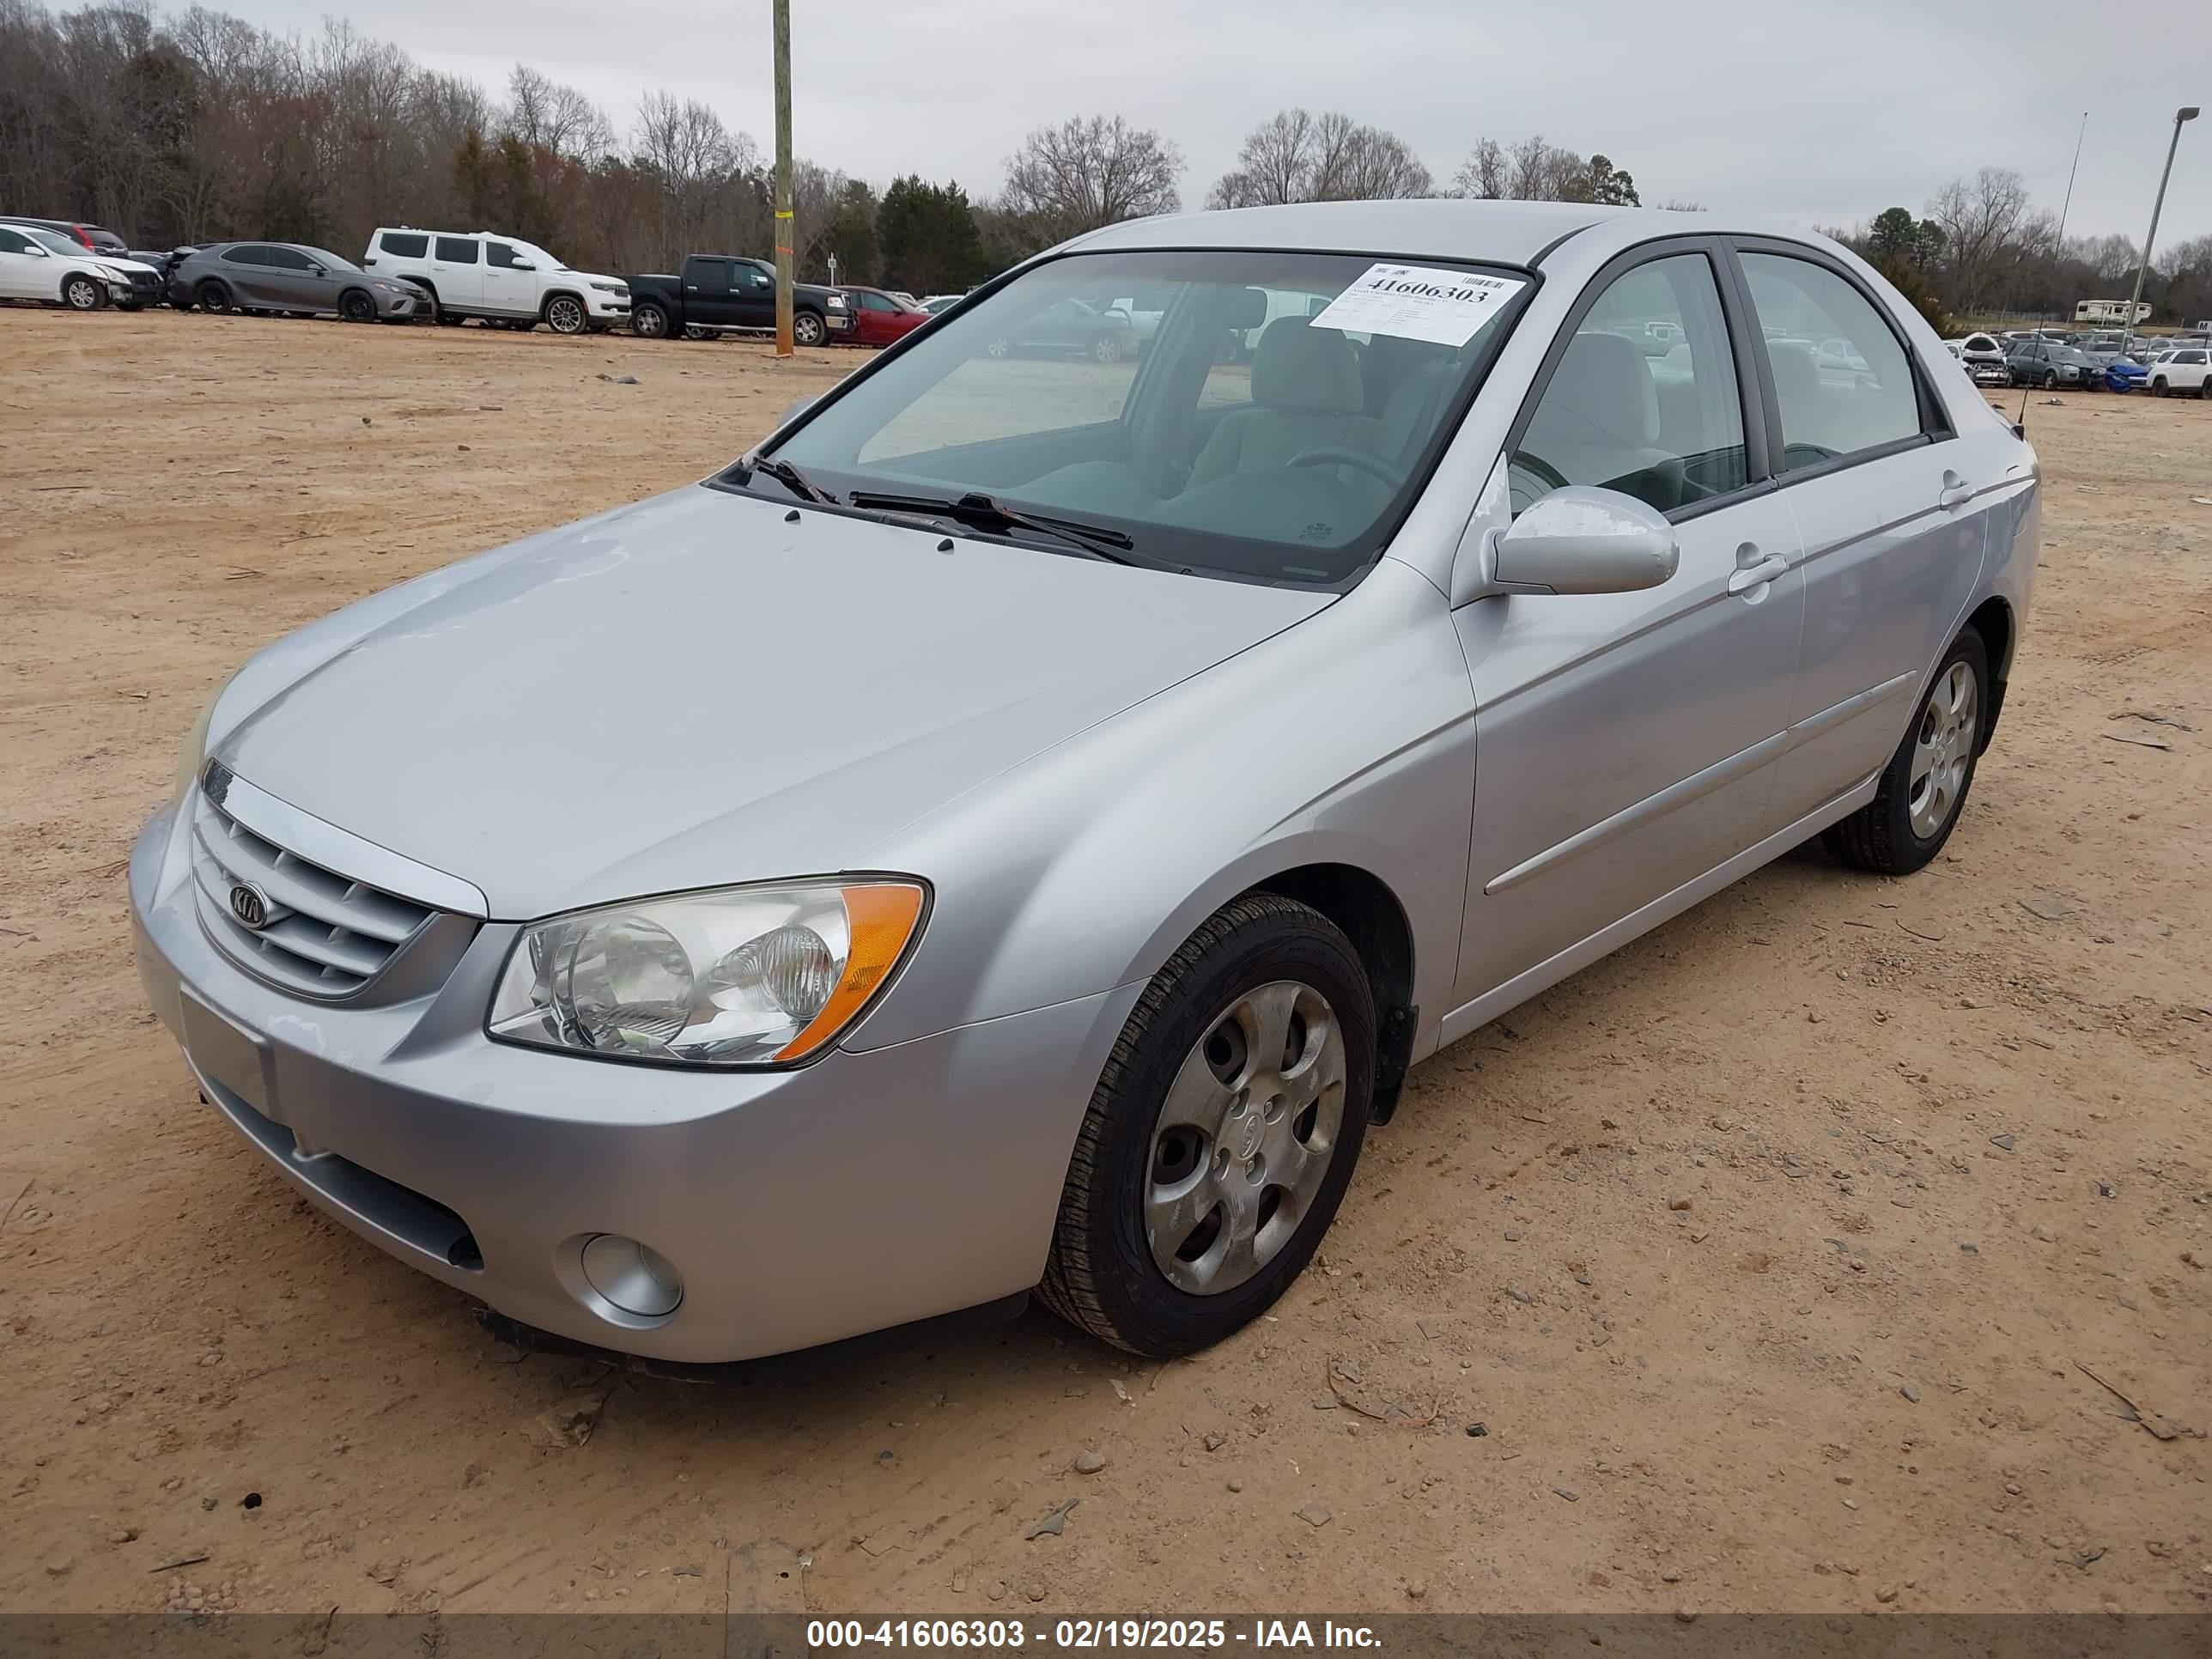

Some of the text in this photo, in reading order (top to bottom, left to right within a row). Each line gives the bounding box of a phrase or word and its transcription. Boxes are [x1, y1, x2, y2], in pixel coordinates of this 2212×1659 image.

[1367, 278, 1489, 303] 41606303
[2199, 322, 2209, 331] M
[234, 888, 258, 921] KIA
